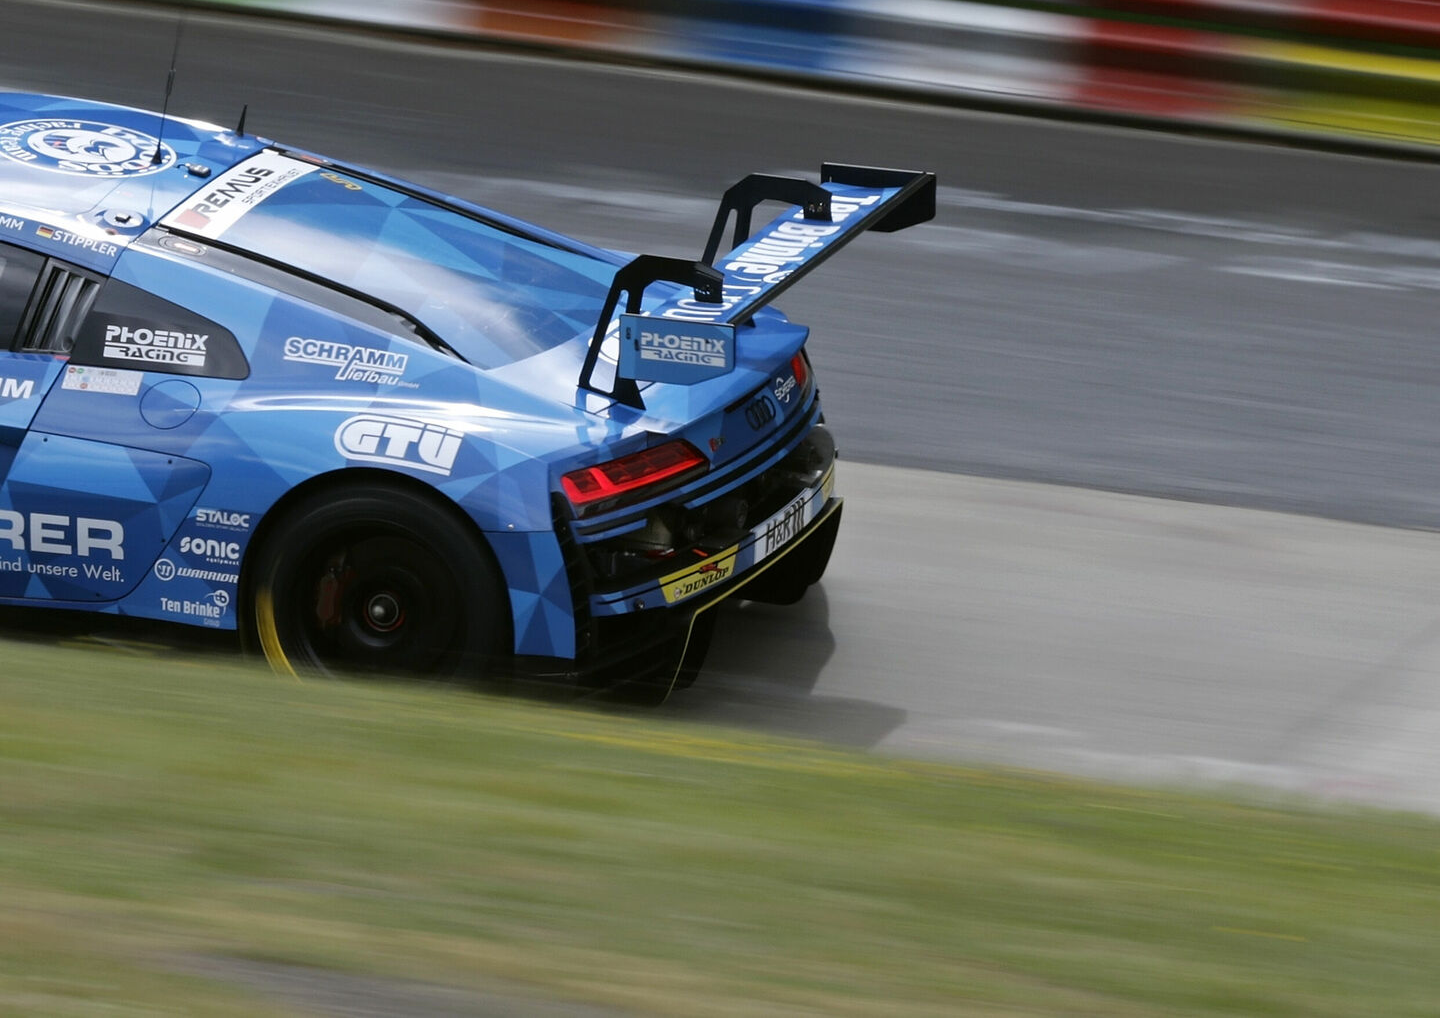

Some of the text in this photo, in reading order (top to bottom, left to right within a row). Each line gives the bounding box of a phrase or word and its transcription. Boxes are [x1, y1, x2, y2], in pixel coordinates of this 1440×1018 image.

[0, 136, 38, 161] team
[191, 166, 275, 220] REMUS
[52, 230, 118, 257] STIPPLER
[285, 337, 407, 370] SCHRAMM
[196, 508, 250, 528] STALOC
[27, 562, 79, 578] unsere
[82, 563, 125, 583] Welt.
[176, 567, 239, 584] WARRIOR
[684, 567, 729, 595] DUNLOP
[160, 597, 220, 618] Ten Brinke
